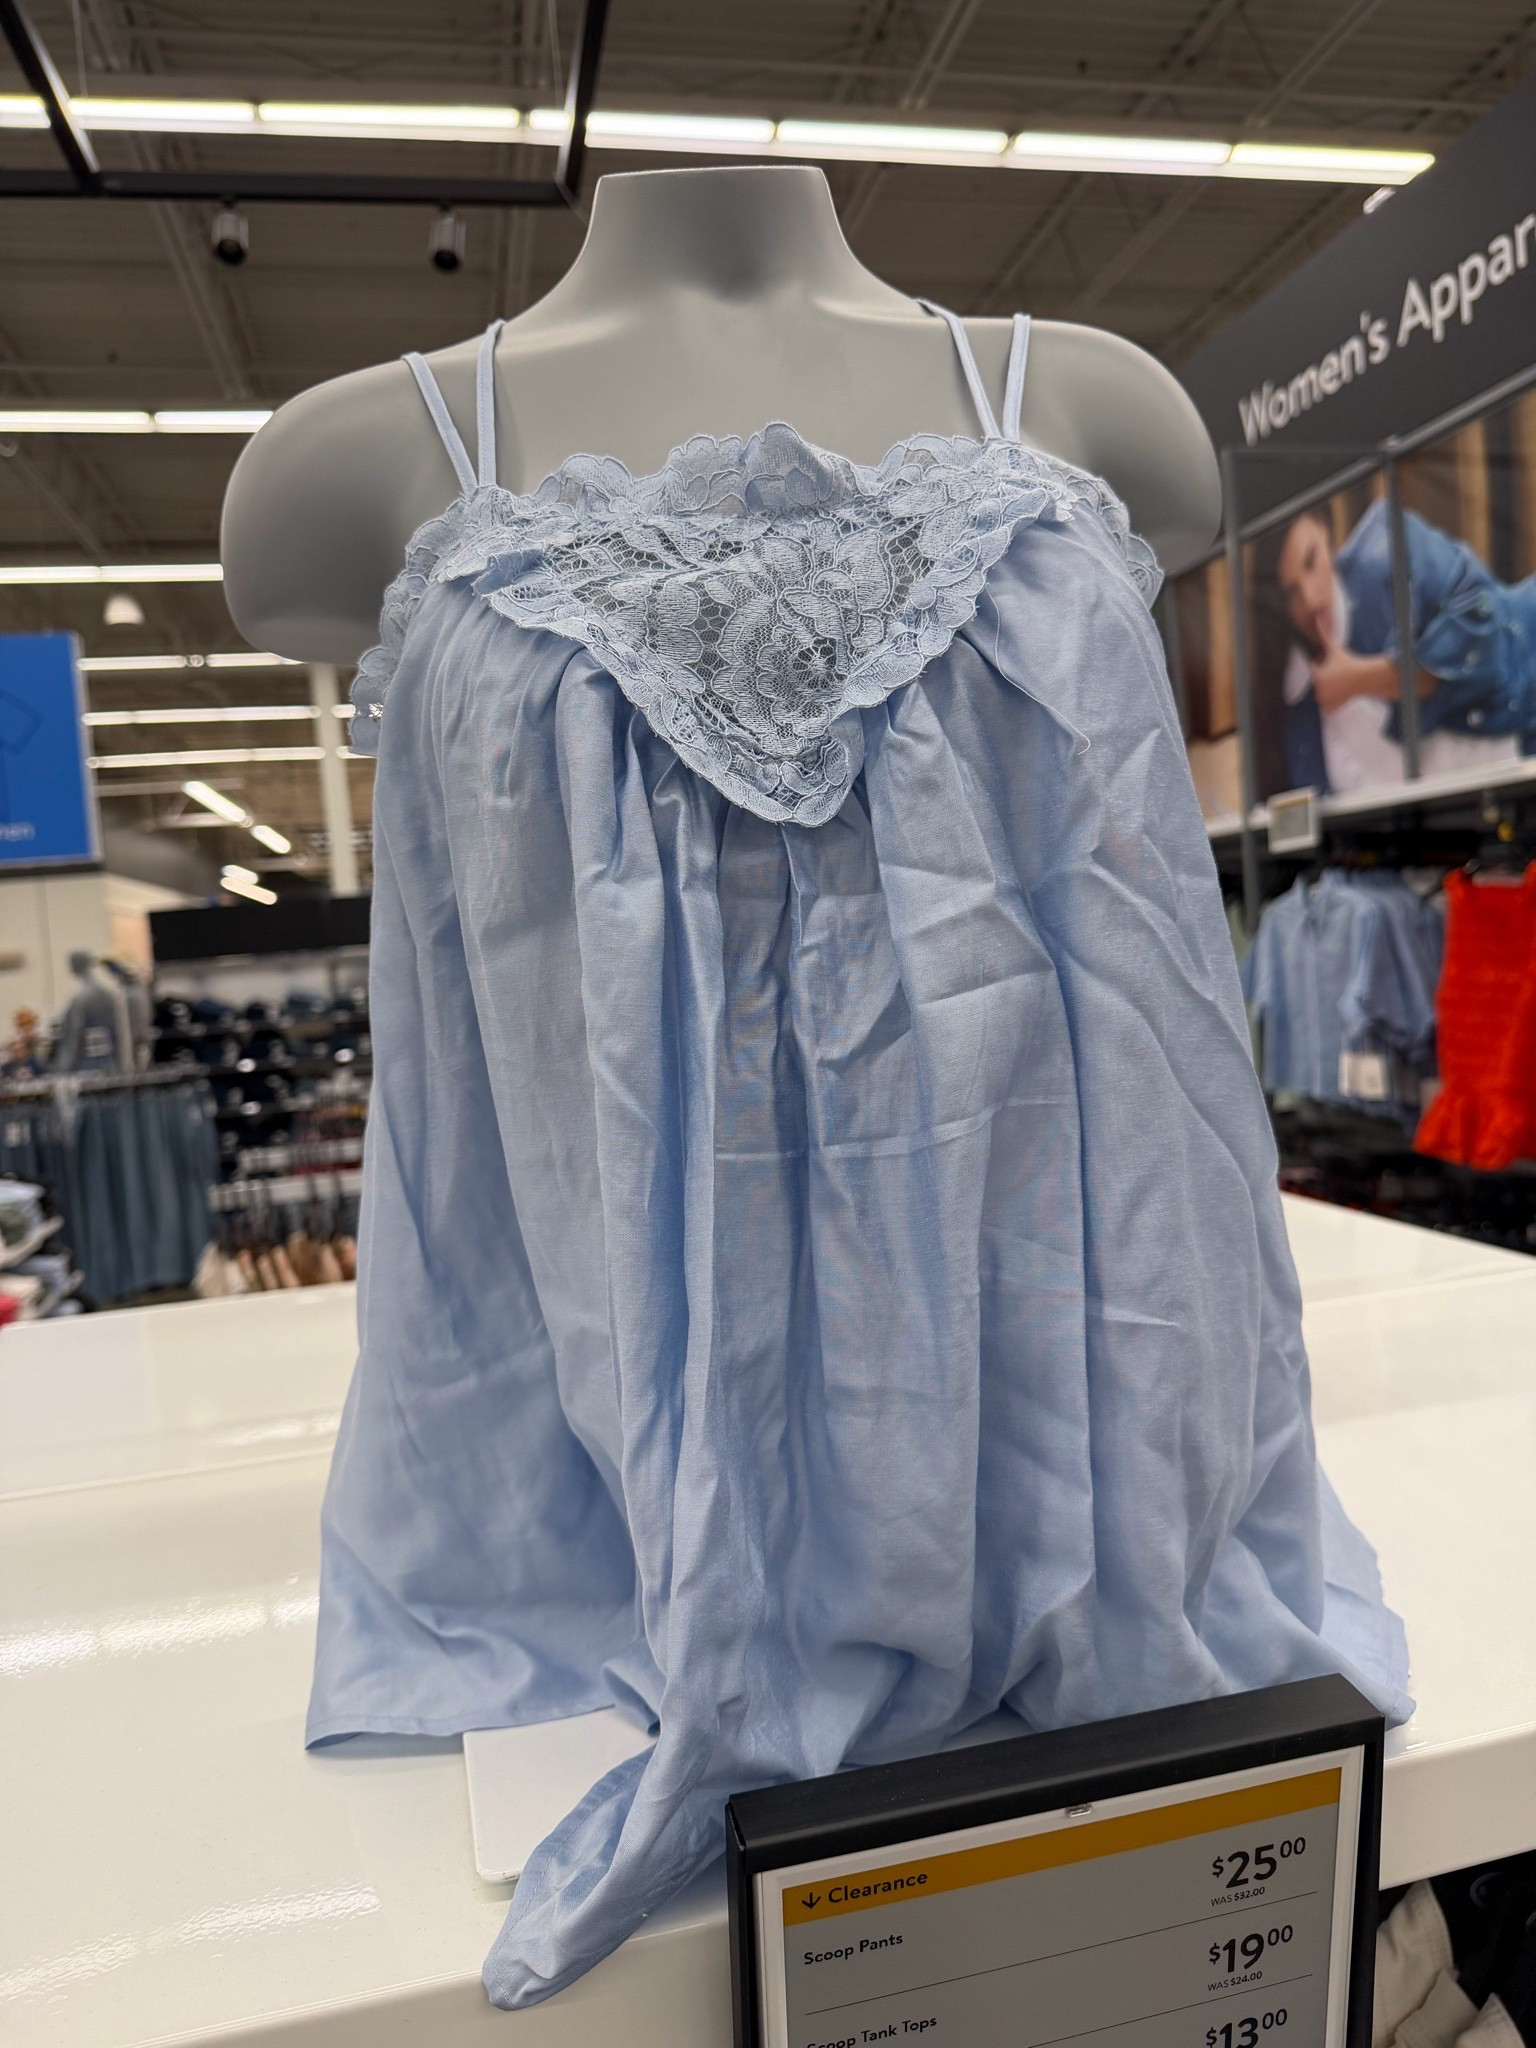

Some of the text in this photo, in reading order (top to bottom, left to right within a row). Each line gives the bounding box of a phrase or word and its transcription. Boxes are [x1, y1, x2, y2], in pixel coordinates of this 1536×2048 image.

[1238, 212, 1536, 448] Women's Appar
[828, 1873, 928, 1903] Clearance
[1210, 1886, 1266, 1907] WAS $32.00
[803, 1934, 903, 1965] Scoop Pants
[1207, 1970, 1263, 1992] WAS $24.00
[861, 2024, 897, 2043] Tank
[902, 2017, 937, 2033] Tops
